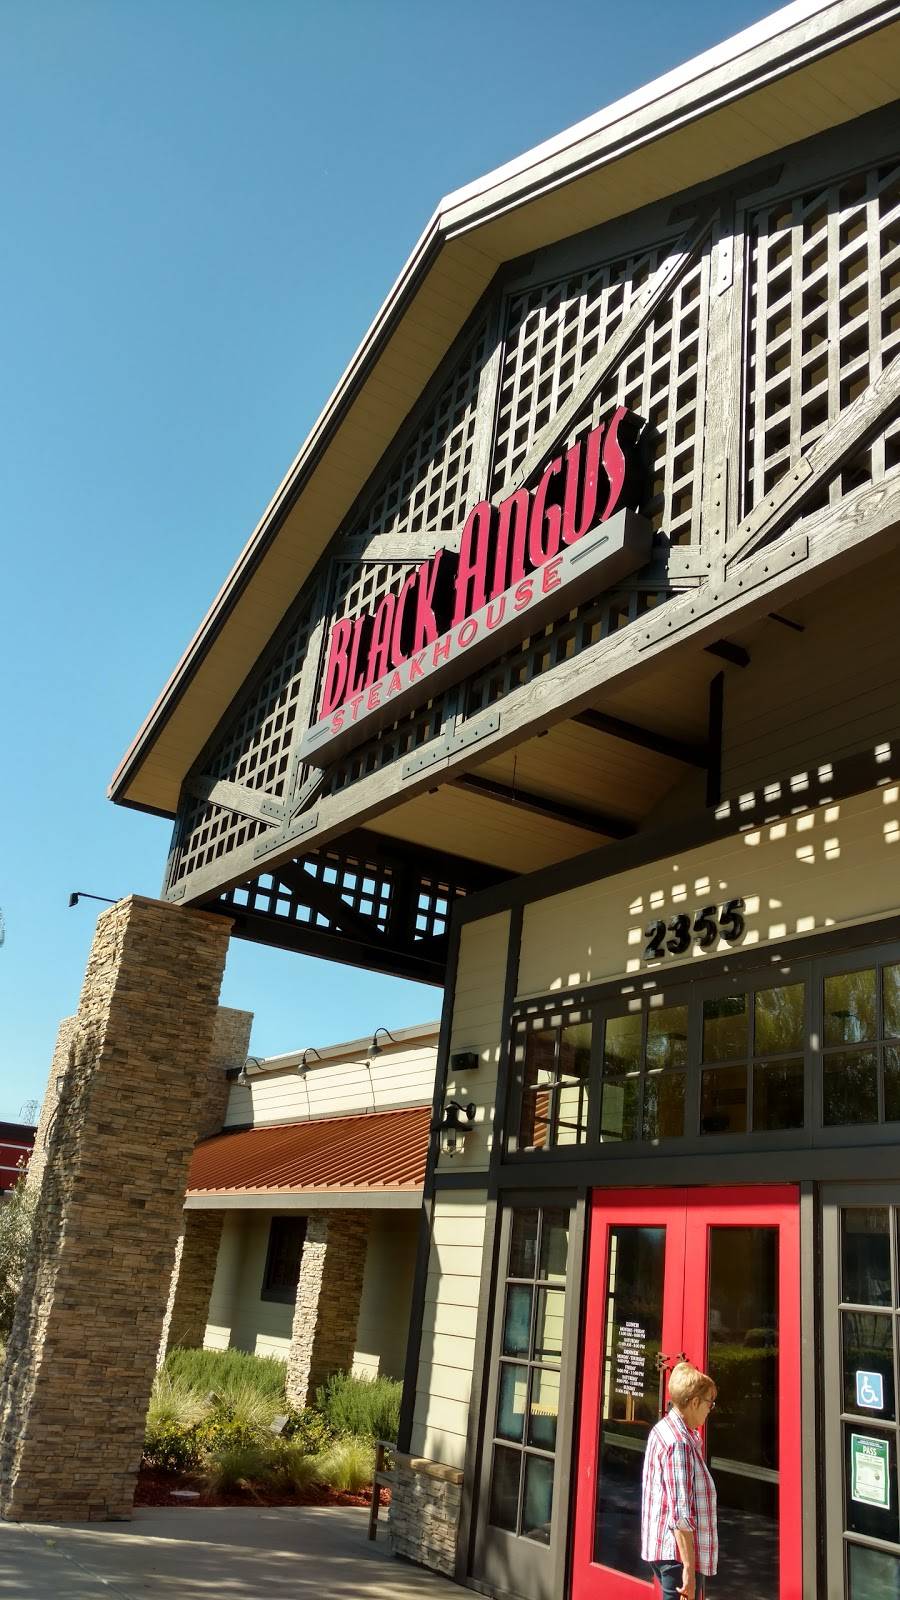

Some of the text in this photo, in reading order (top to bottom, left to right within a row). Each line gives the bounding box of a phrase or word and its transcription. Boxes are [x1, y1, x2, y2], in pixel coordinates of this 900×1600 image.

[319, 405, 628, 720] BLACK ANGUS
[329, 556, 564, 735] STEAKHOUSE
[644, 898, 746, 960] 2355
[862, 1445, 877, 1456] PASS
